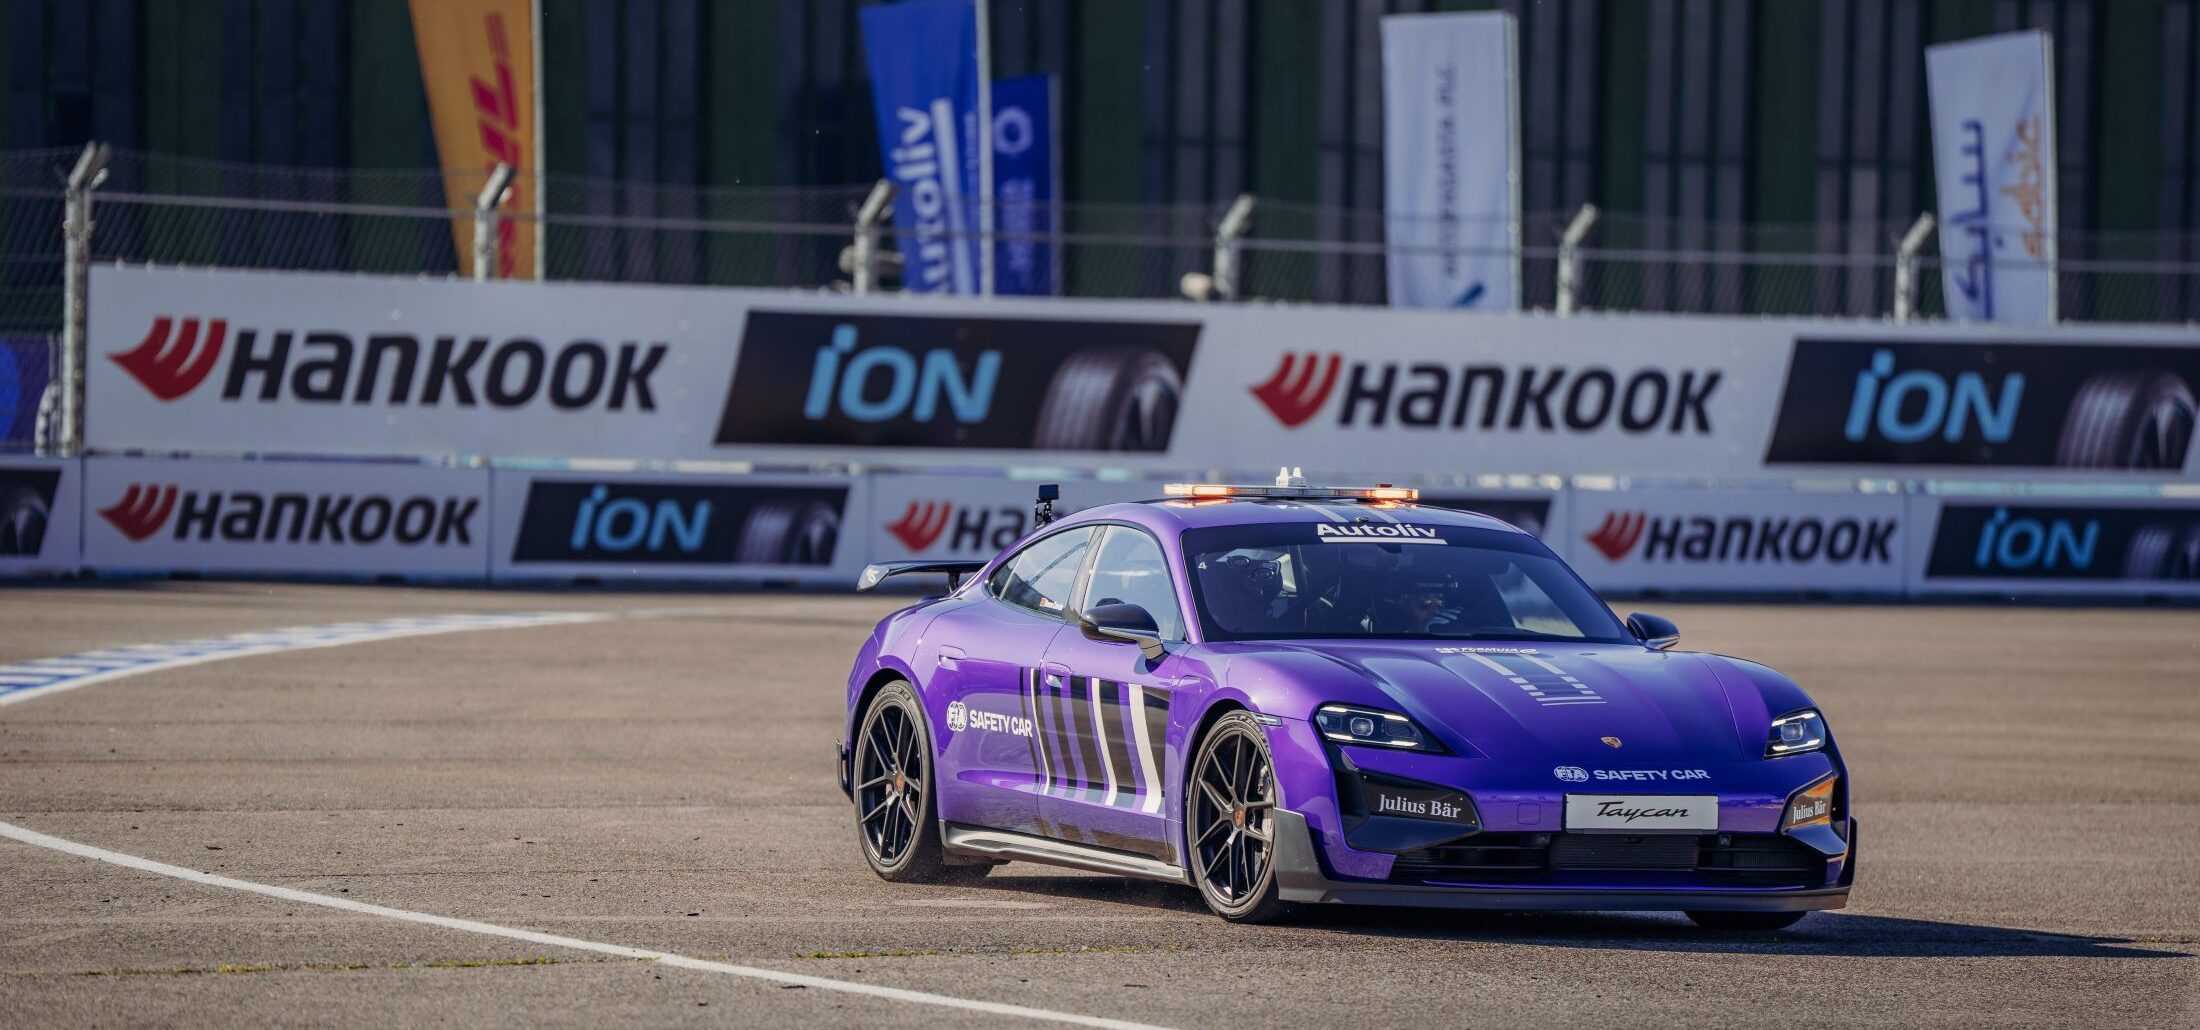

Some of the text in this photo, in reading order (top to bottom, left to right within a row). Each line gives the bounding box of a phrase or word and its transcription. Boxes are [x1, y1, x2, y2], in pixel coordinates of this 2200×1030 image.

[804, 324, 1002, 423] iON
[1844, 349, 2026, 443] iON
[570, 484, 711, 550] iON
[1317, 523, 1436, 538] Autoliv
[1974, 507, 2099, 569] iON
[970, 709, 1010, 733] SAFETY
[1011, 716, 1033, 737] CAR
[1556, 767, 1711, 781] FIA SAFETY CAR
[1379, 794, 1462, 818] Julius Bär
[1597, 801, 1689, 823] Taycan
[1792, 804, 1814, 824] Julius
